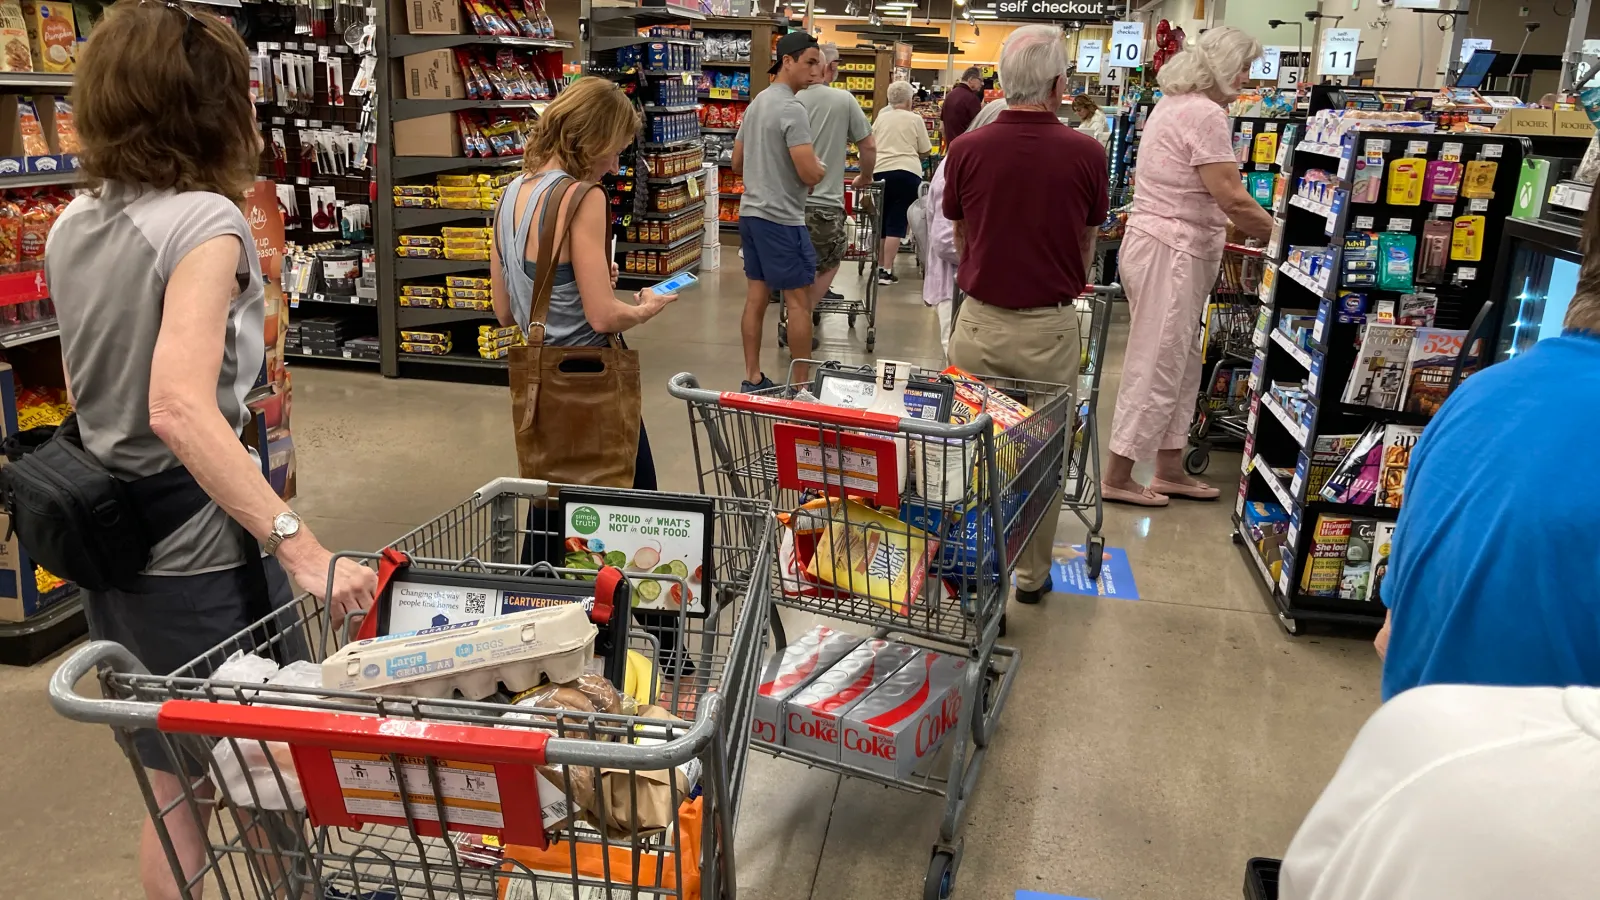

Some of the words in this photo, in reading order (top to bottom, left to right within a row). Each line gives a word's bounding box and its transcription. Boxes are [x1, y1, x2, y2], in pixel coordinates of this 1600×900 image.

[999, 0, 1028, 13] self
[1032, 1, 1104, 15] checkout
[44, 28, 74, 42] Pumpkin
[1114, 43, 1138, 60] 10
[1085, 55, 1095, 68] 7
[1329, 50, 1352, 69] 11
[1107, 68, 1117, 81] 4
[1262, 62, 1272, 75] 8
[1287, 71, 1297, 84] 5
[1516, 119, 1548, 129] ROCHER
[1560, 121, 1592, 131] ROCHER
[1443, 154, 1460, 162] 3.79
[247, 207, 268, 227] glade
[260, 238, 270, 248] up
[1345, 240, 1367, 249] Advil
[255, 247, 278, 260] eason
[1403, 299, 1436, 311] Energizer
[1378, 311, 1393, 320] 9.79
[1369, 327, 1392, 337] Home
[1366, 336, 1409, 349] COLOR
[923, 391, 942, 401] WORK?
[575, 512, 597, 523] simple
[575, 519, 597, 528] truth
[609, 513, 641, 524] PROUD
[644, 516, 653, 526] of
[656, 517, 691, 528] WHAT'S
[608, 523, 629, 533] NOT
[630, 525, 638, 533] in
[640, 526, 660, 536] OUR
[663, 527, 691, 539] FOOD.
[1320, 528, 1345, 537] World
[1315, 543, 1332, 552] She
[1332, 543, 1348, 551] lost
[868, 541, 896, 581] THINS
[1323, 551, 1339, 559] age
[400, 588, 433, 600] Changing
[433, 591, 446, 600] the
[446, 593, 460, 602] way
[398, 599, 421, 610] people
[422, 600, 436, 610] find
[436, 602, 460, 611] homes
[420, 625, 454, 636] GRADE
[460, 620, 476, 628] AA
[475, 638, 504, 653] EGGS
[390, 653, 424, 669] Large
[395, 662, 433, 679] GRADE
[436, 659, 453, 670] AA
[788, 712, 839, 745] Coke
[820, 719, 836, 729] Diet
[915, 695, 962, 759] Coke
[844, 728, 897, 762] Coke
[877, 734, 894, 745] Diet
